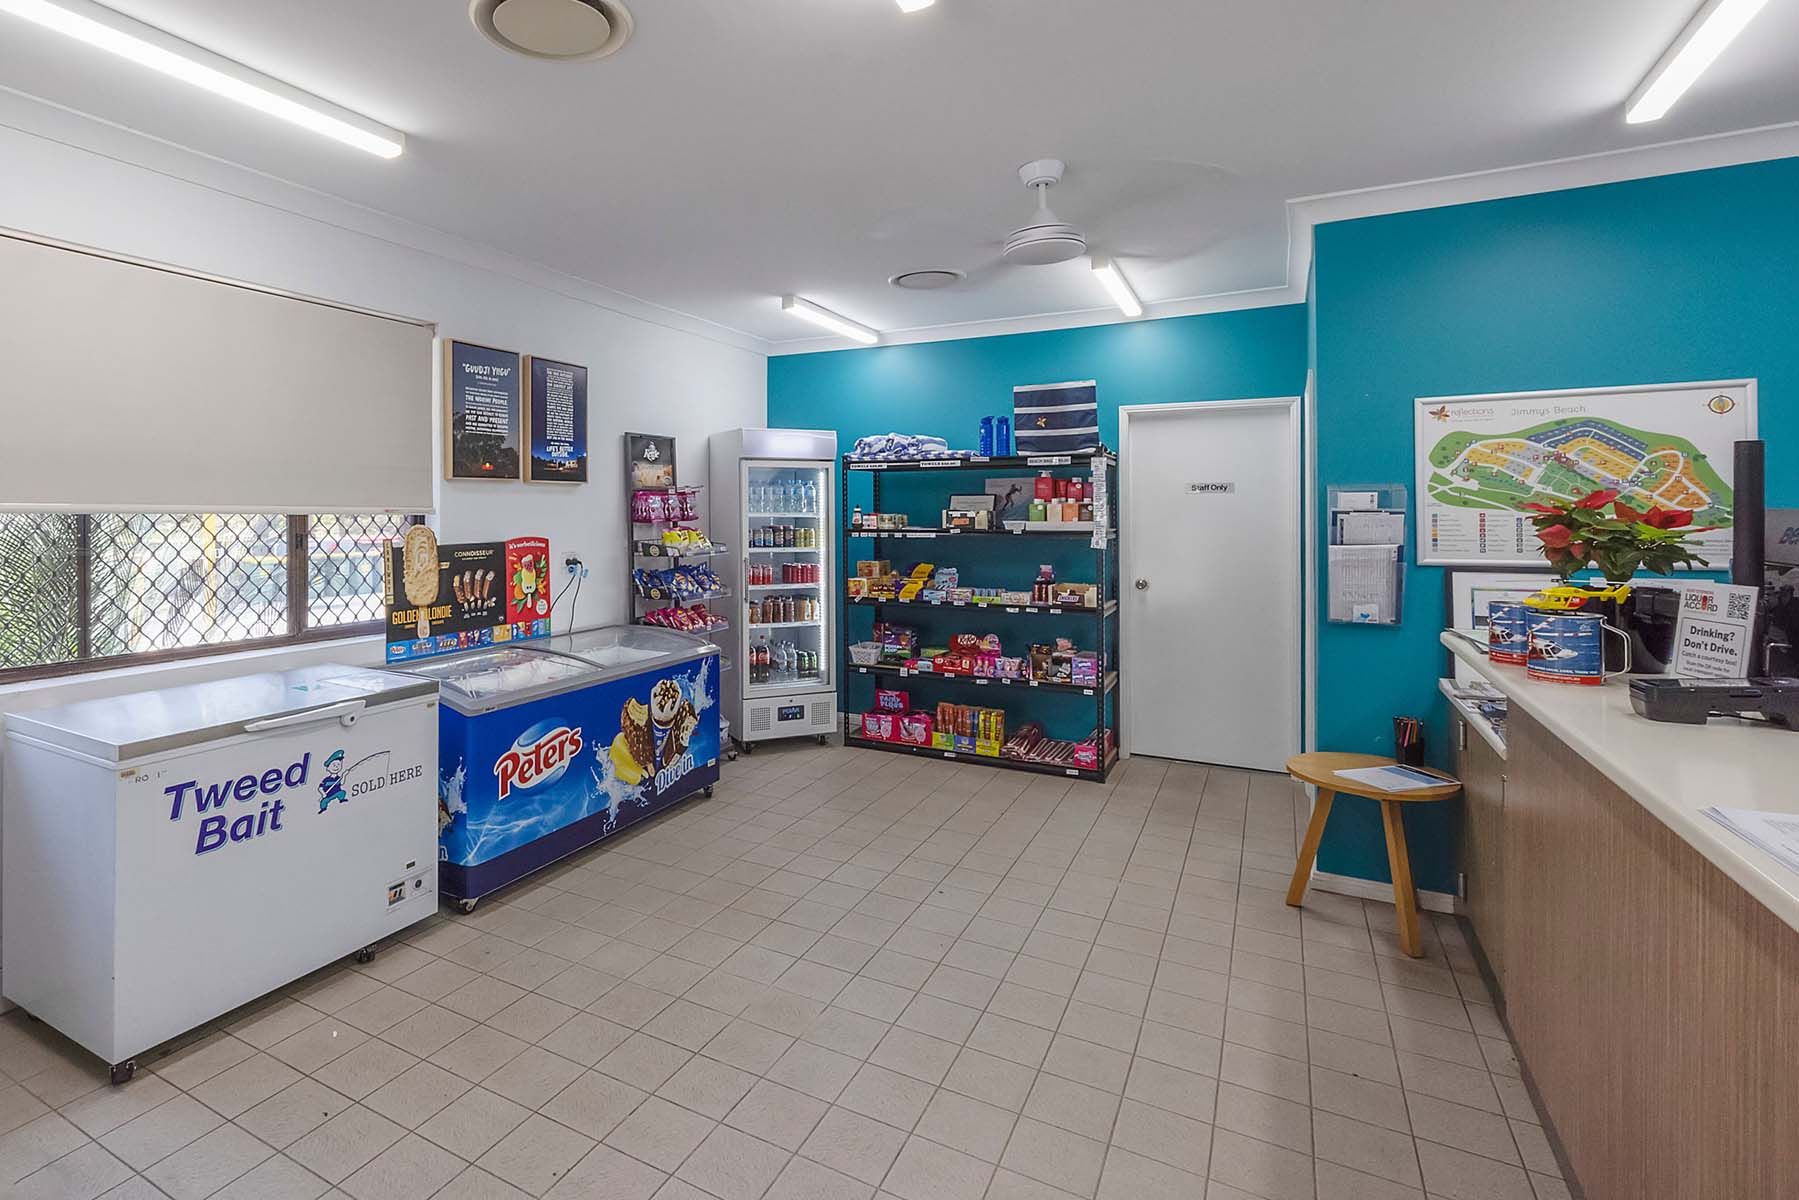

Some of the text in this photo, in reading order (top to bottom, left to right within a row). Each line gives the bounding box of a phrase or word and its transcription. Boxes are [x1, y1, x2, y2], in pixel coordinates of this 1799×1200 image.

[1511, 405, 1586, 417] Jimmys Beach
[1211, 484, 1228, 493] Only
[1684, 638, 1738, 656] Don't Drive.
[1690, 625, 1736, 642] Drinking?
[494, 727, 583, 800] Peters
[655, 753, 694, 797] Dive in
[164, 751, 311, 822] Tweed
[351, 765, 423, 798] SOLD HERE
[195, 799, 287, 856] Bait
